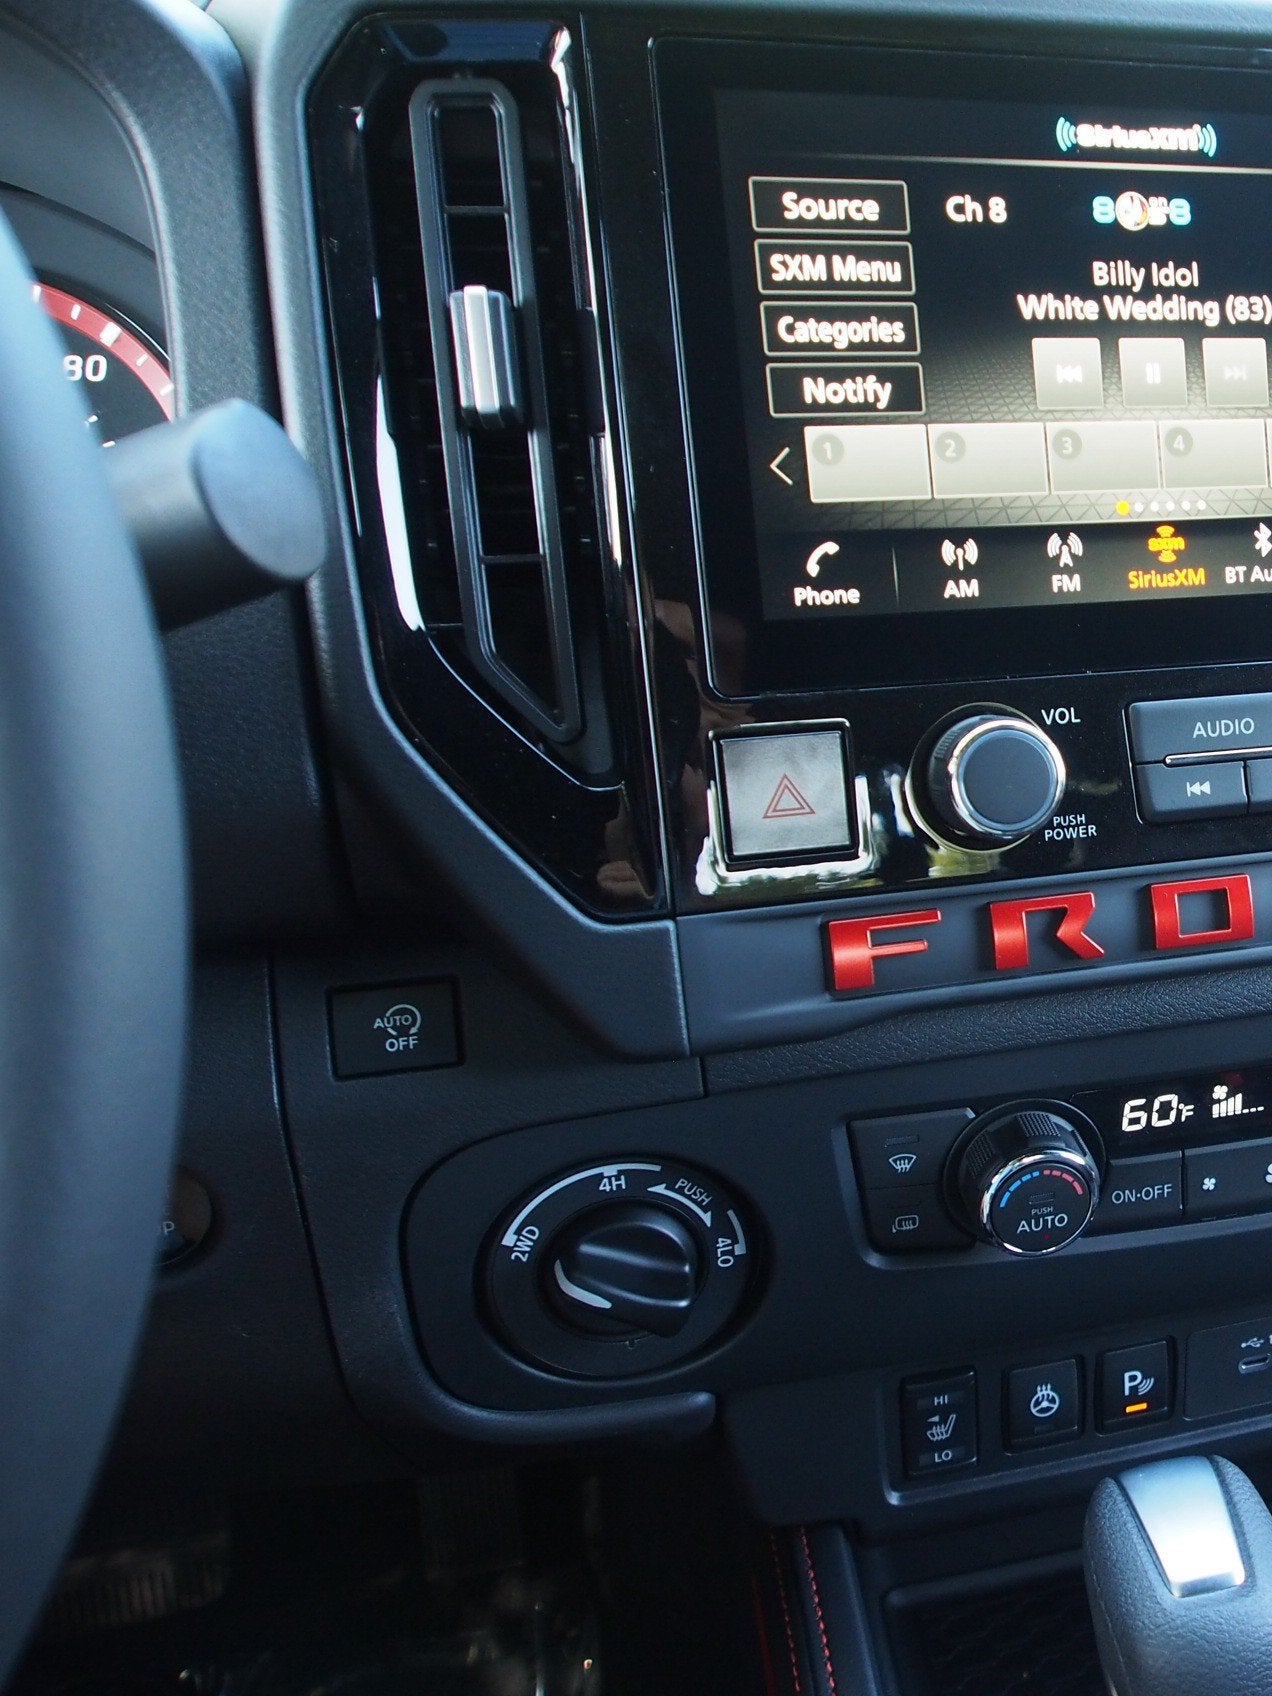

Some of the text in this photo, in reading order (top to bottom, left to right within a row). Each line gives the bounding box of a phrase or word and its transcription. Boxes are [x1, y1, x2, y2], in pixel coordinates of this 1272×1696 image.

[782, 192, 880, 222] Source
[945, 196, 1008, 223] Ch 8
[769, 254, 902, 283] SXM Menu
[1092, 260, 1199, 293] Billy Idol
[1017, 293, 1099, 322] White
[1104, 294, 1221, 327] Wedding
[777, 315, 906, 350] Categories
[802, 375, 893, 410] Notify
[1051, 573, 1081, 594] FM
[1128, 567, 1206, 590] SiriusXM
[1225, 565, 1247, 584] BT
[794, 585, 861, 607] Phone
[943, 578, 980, 599] AM
[1041, 706, 1081, 726] VOL
[1192, 717, 1255, 738] AUDIO
[1052, 813, 1086, 828] PUSH
[1044, 823, 1098, 842] POWER
[373, 1013, 412, 1030] AUTO
[385, 1035, 419, 1053] OFF
[598, 1174, 626, 1193] 4H
[674, 1176, 713, 1206] PUSH
[1031, 1205, 1054, 1216] PUSH
[1016, 1212, 1069, 1235] AUTO
[511, 1225, 540, 1263] 2WD
[716, 1235, 735, 1269] 4LO
[934, 1394, 948, 1406] HI
[934, 1450, 952, 1463] LO
